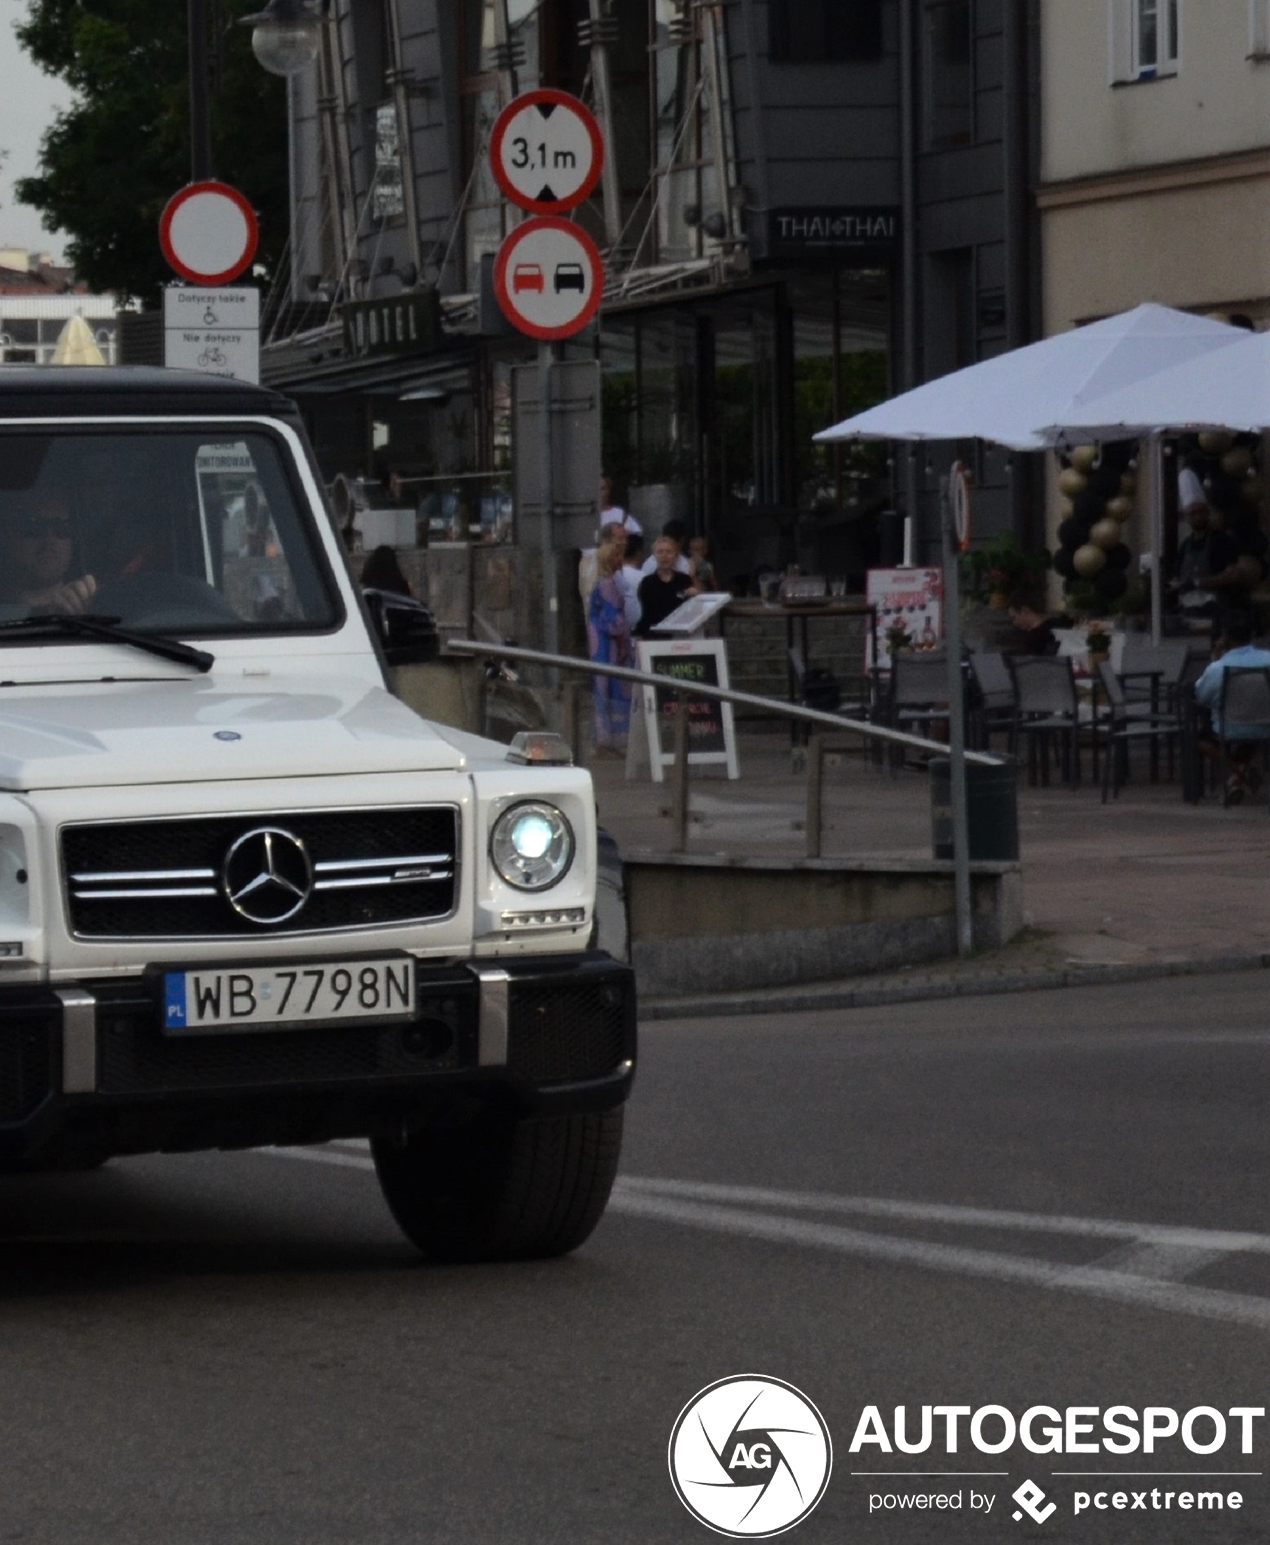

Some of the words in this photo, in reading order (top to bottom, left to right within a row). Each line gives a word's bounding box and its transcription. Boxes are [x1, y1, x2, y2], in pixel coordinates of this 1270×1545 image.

[511, 137, 546, 171] 3,1
[553, 151, 576, 168] m
[776, 216, 829, 237] THAI
[842, 216, 894, 237] THAI
[178, 293, 216, 305] Dotyczy
[183, 333, 200, 342] Nie
[204, 333, 242, 345] dotyczy
[193, 974, 257, 1020] WB
[275, 964, 410, 1016] 7798N
[168, 1005, 184, 1018] PL
